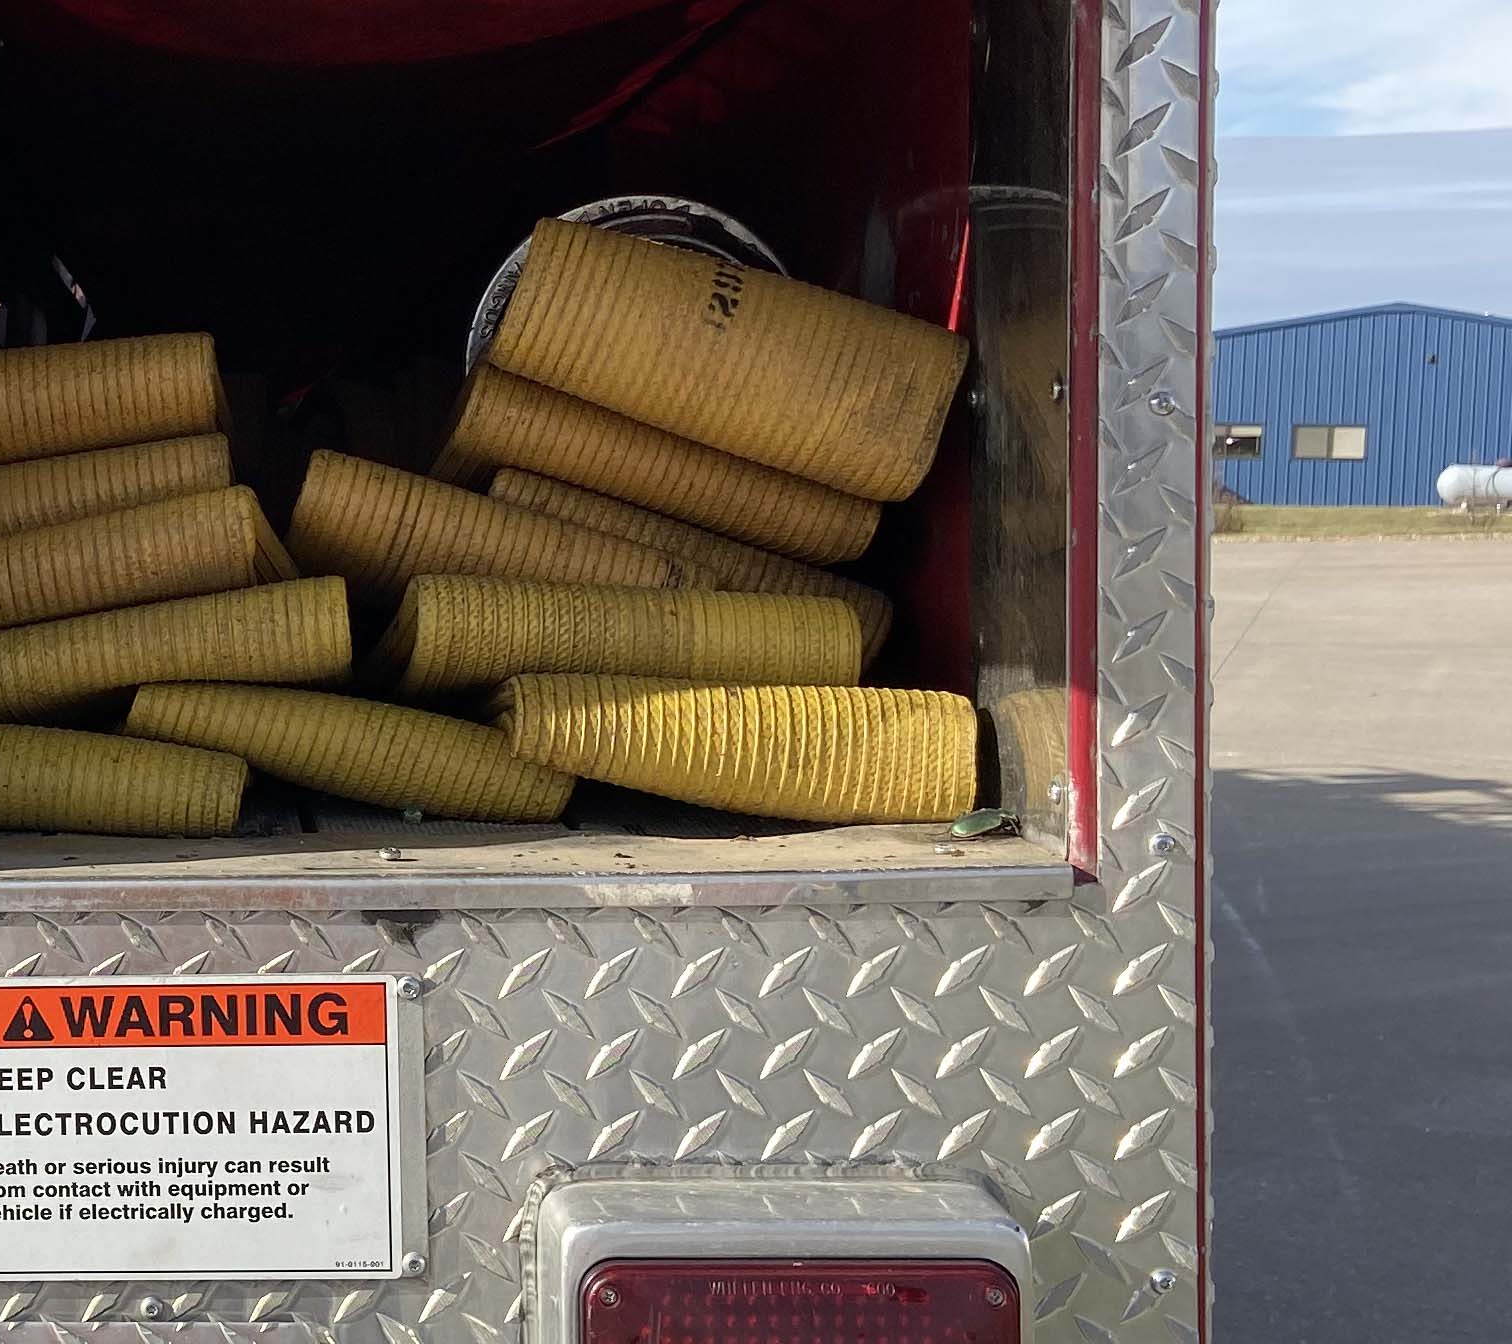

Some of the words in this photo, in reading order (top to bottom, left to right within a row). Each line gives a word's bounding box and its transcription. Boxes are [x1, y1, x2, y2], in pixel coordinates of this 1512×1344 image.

[62, 992, 349, 1037] WARNING
[67, 1067, 166, 1090] CLEAR
[250, 1111, 374, 1133] HAZARD
[45, 1163, 66, 1174] or
[73, 1159, 151, 1174] serious
[159, 1158, 217, 1177] injury
[225, 1161, 261, 1173] can
[270, 1157, 329, 1172] result
[33, 1182, 110, 1197] contact
[117, 1181, 160, 1196] with
[169, 1181, 280, 1200] equipment
[288, 1184, 309, 1195] or
[60, 1204, 72, 1219] if
[79, 1203, 194, 1223] electrically
[201, 1203, 293, 1222] charged.
